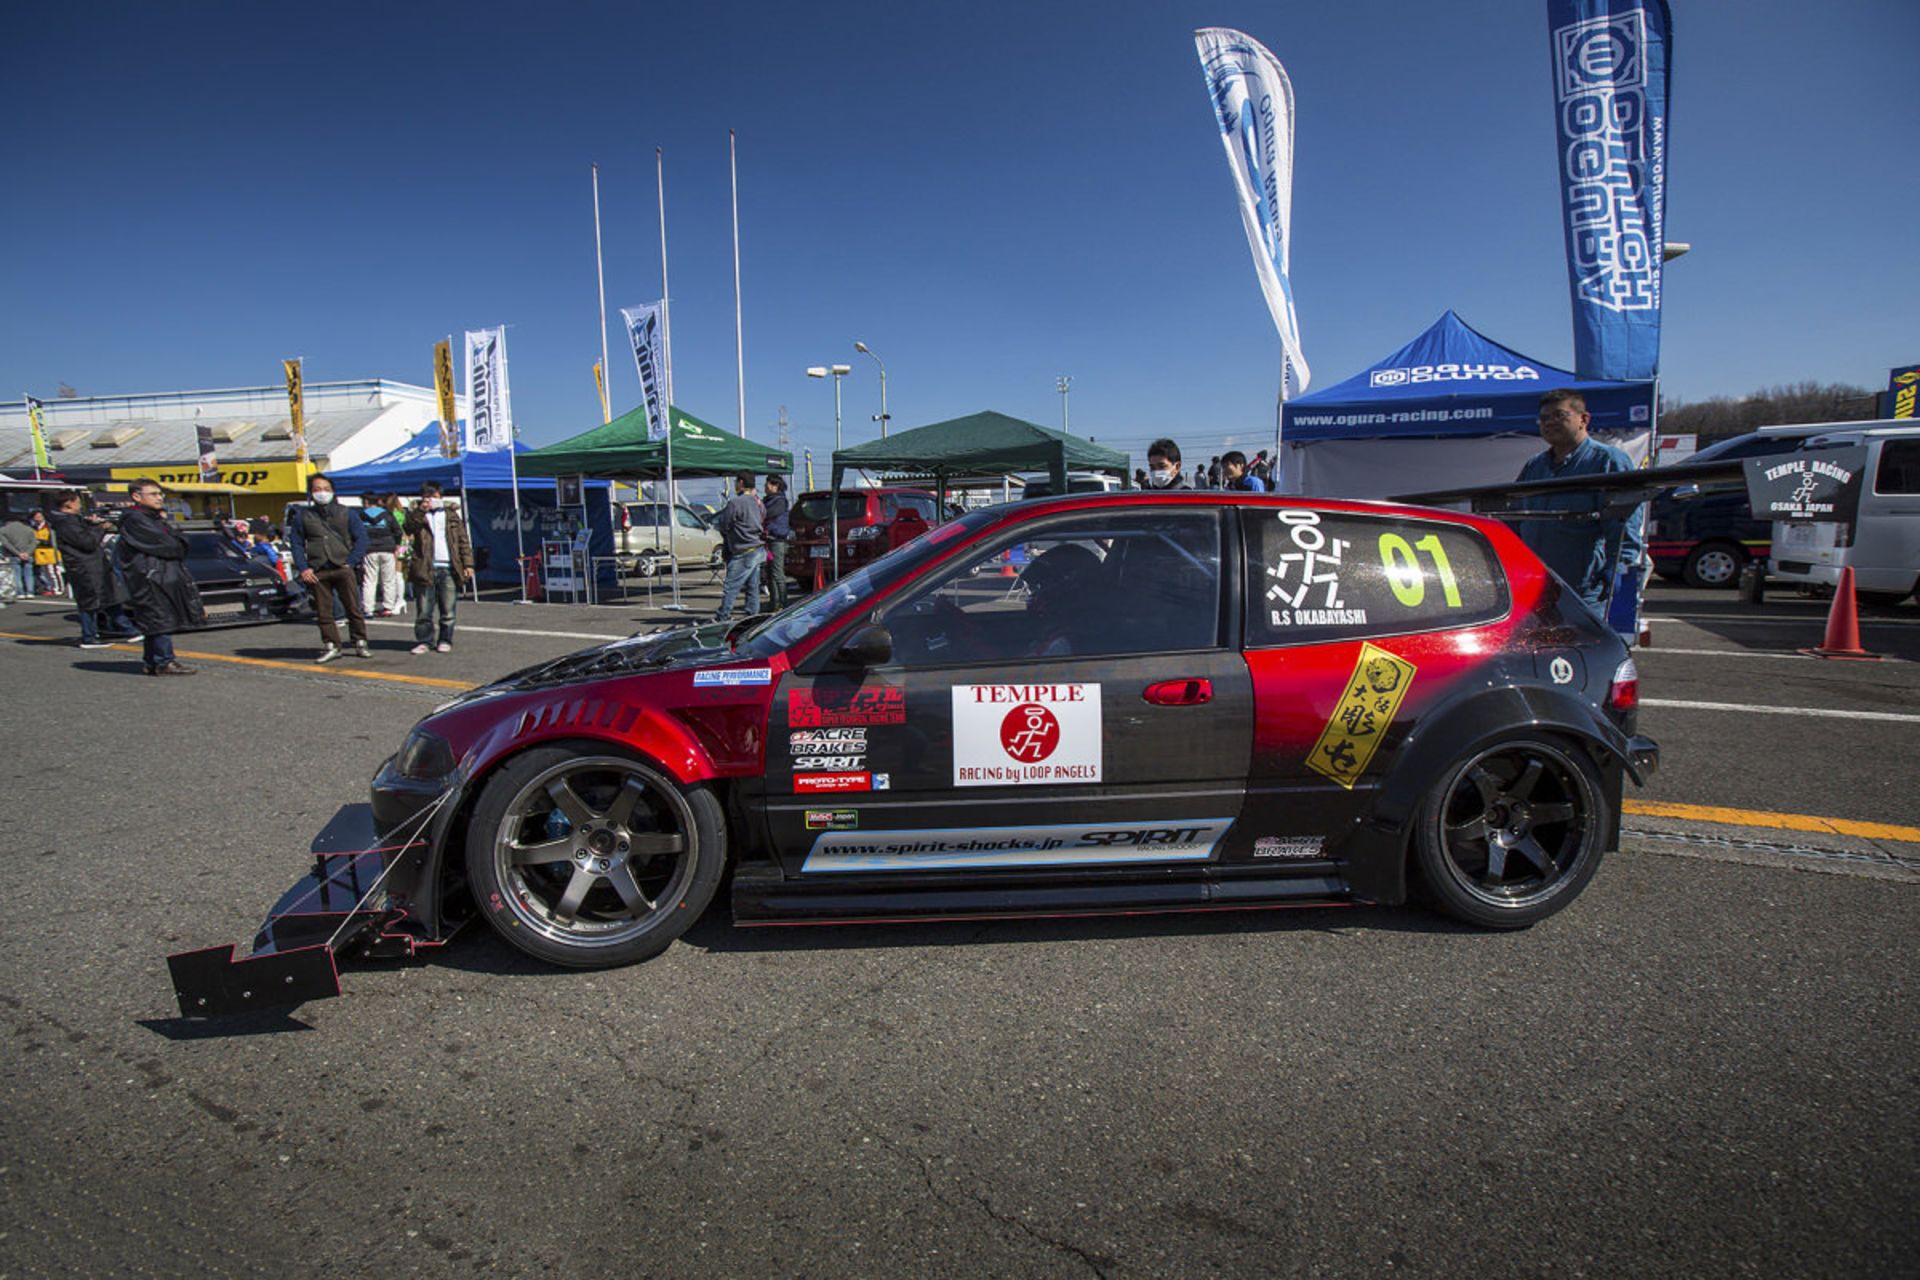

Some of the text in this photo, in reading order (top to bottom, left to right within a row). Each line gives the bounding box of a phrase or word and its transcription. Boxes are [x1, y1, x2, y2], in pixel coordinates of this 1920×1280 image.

[1410, 371, 1540, 383] CLUTCH
[1411, 364, 1539, 374] OGURA
[1293, 407, 1493, 427] www.ogura-racing.com
[1764, 460, 1852, 484] TEMPLE RACING
[1770, 502, 1834, 513] OSAKA JAPAN
[1378, 532, 1463, 608] 01
[1271, 608, 1368, 625] R.S OKABAYASHI
[970, 684, 1086, 704] TEMPLE
[811, 727, 868, 742] ACRE
[789, 741, 868, 755] BRAKES
[792, 755, 867, 770] SPIRIT
[798, 776, 866, 785] PROTO-TYPE
[959, 764, 1097, 783] RACING by LOOP ANGELS
[1074, 826, 1213, 849] SPIRIT
[823, 837, 1064, 857] www.spirit-shocks.jp
